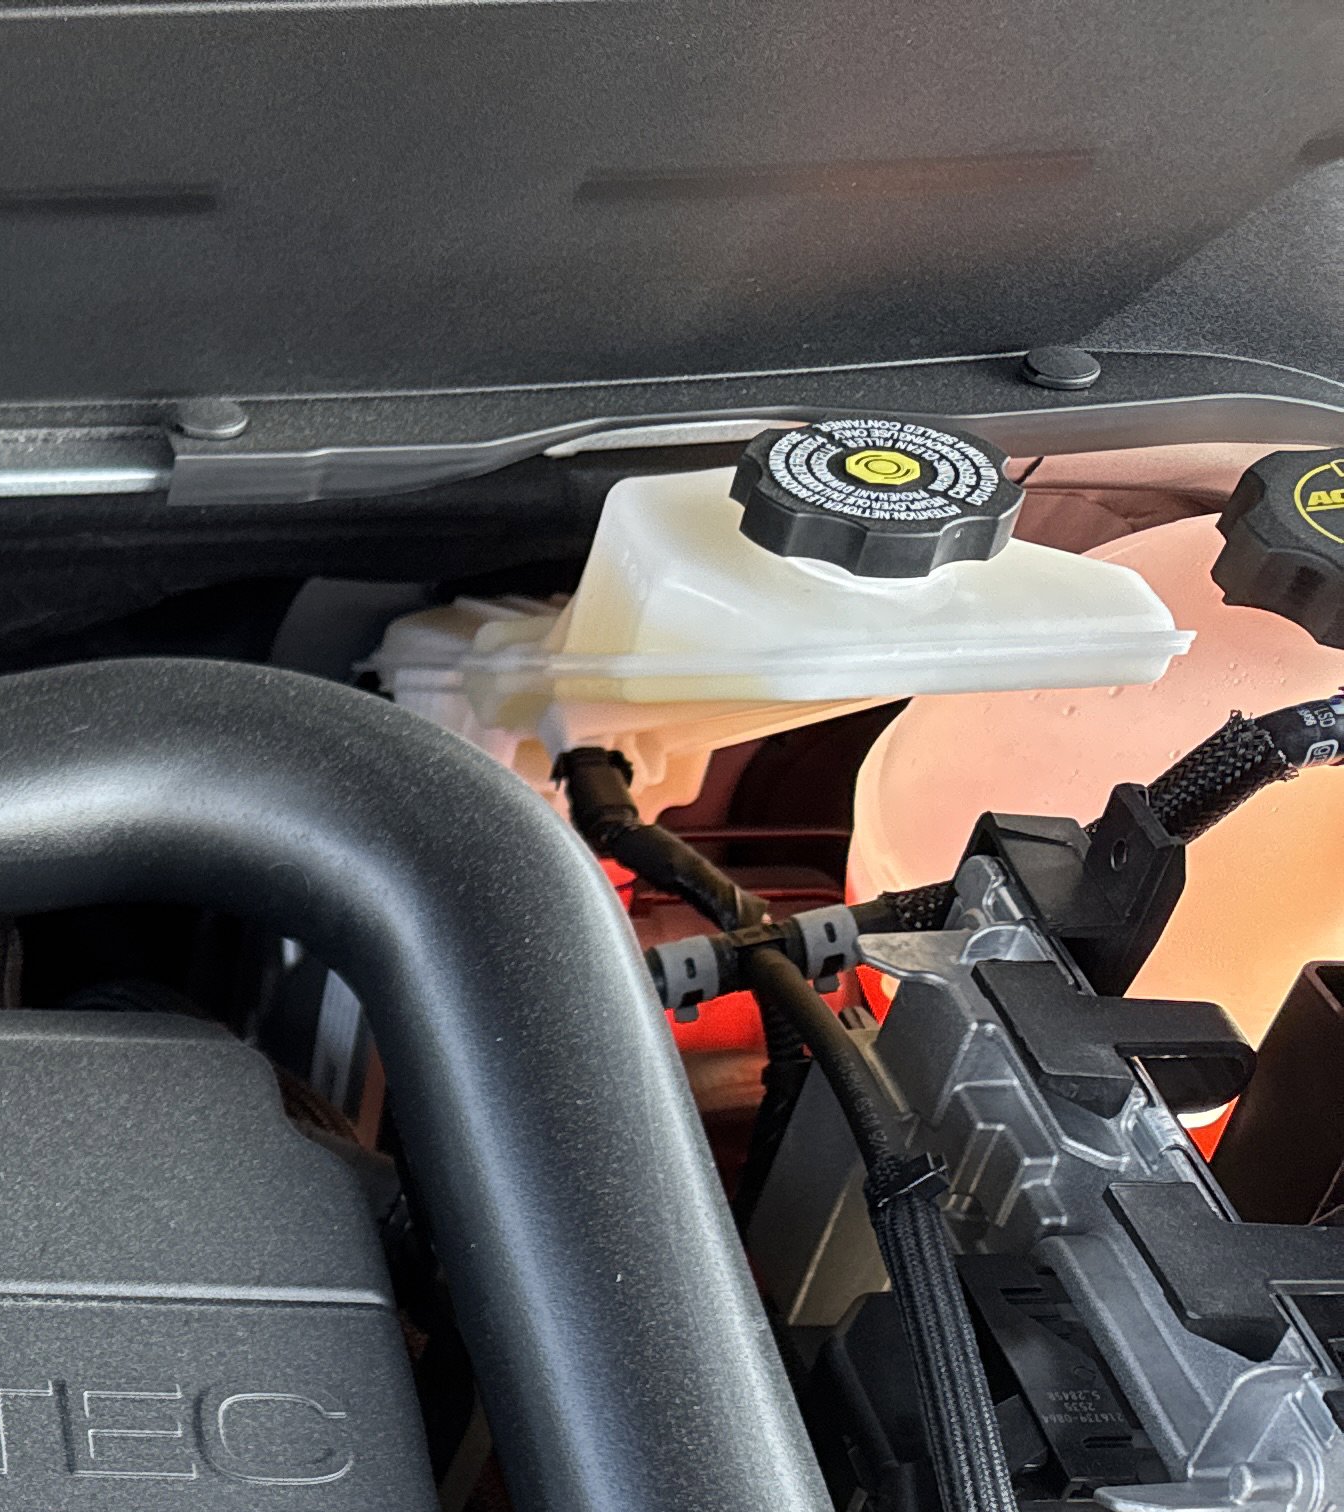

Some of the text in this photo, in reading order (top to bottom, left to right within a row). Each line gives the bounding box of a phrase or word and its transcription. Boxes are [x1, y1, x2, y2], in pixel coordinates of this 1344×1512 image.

[826, 428, 870, 441] ONLY
[868, 429, 899, 439] USE
[901, 423, 961, 444] SEALED
[839, 437, 894, 449] FILLER
[897, 432, 966, 460] REMOVING
[950, 440, 972, 449] A
[894, 440, 946, 460] CLEAN
[959, 445, 994, 466] FROM
[801, 493, 829, 505] LE
[822, 490, 848, 501] DU
[849, 487, 933, 501] PROVENANT
[840, 495, 871, 507] QUE
[818, 499, 890, 520] NETTOYER
[890, 503, 966, 520] ATTENTION:
